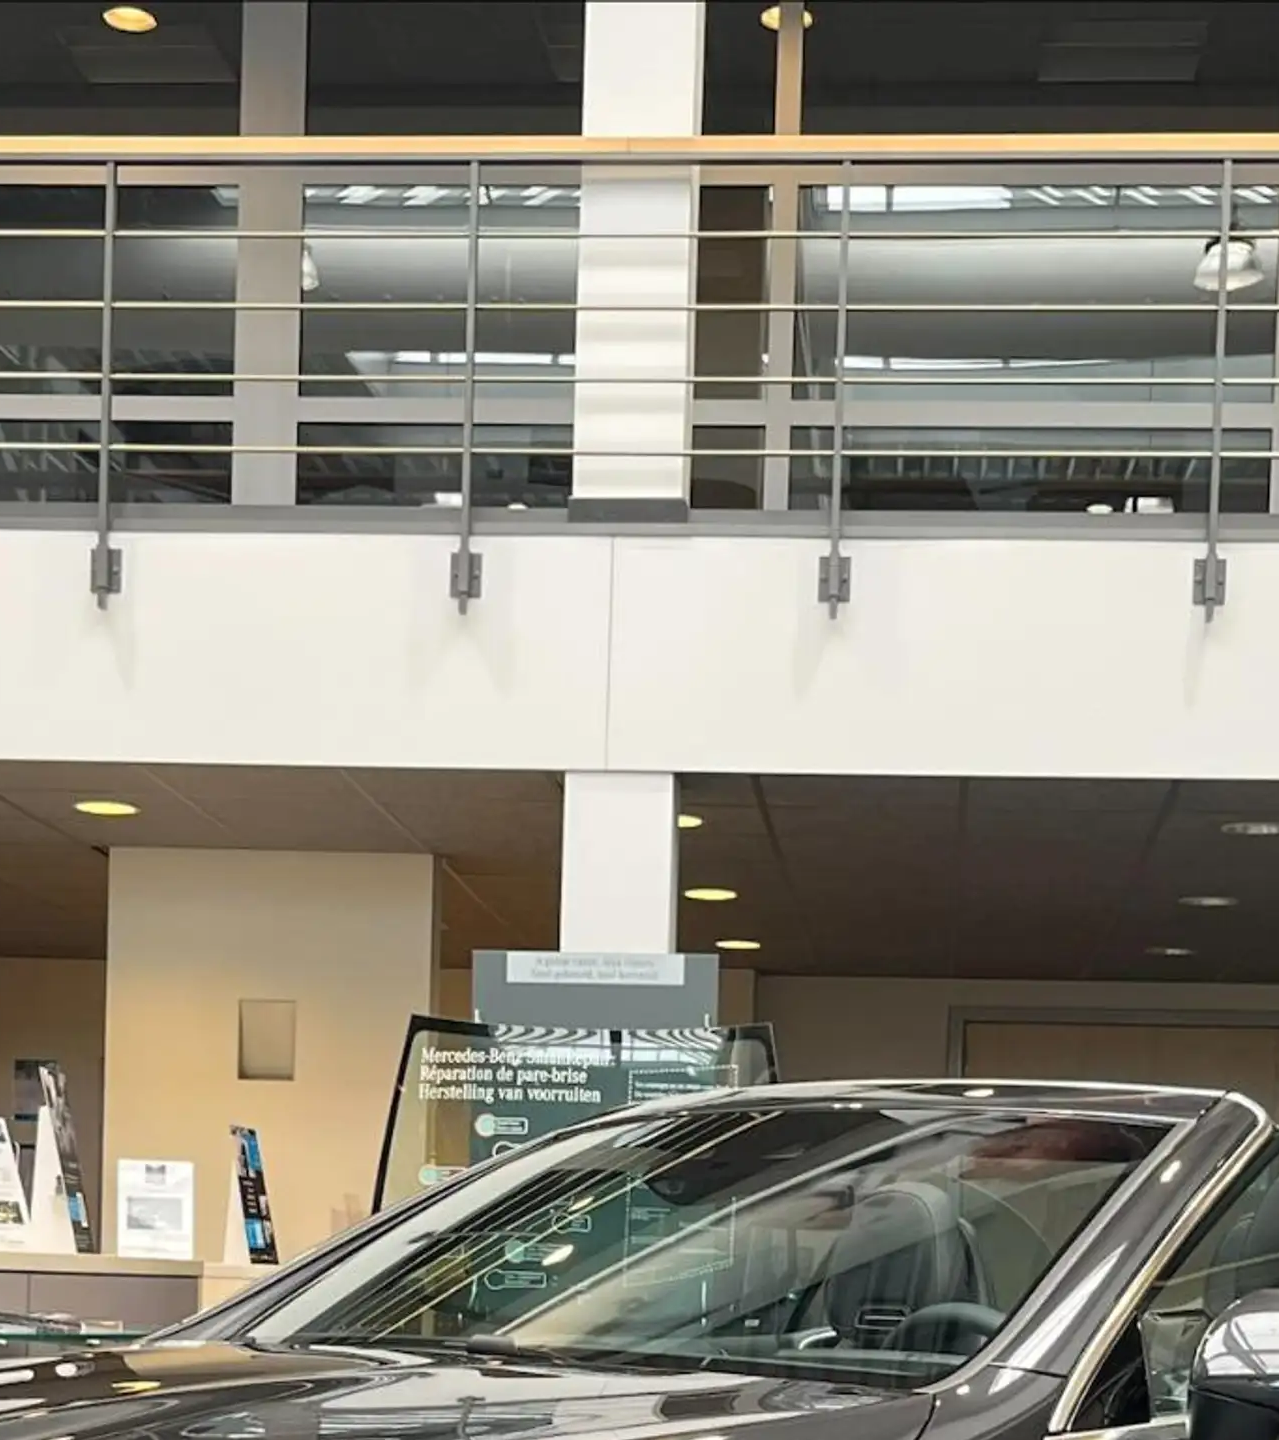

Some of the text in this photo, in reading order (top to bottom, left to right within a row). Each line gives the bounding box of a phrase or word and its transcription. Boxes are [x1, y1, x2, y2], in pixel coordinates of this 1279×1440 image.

[420, 1046, 522, 1067] Mercedes-Benz
[419, 1064, 588, 1086] Réparation de pare-brise
[418, 1083, 602, 1104] Herstelling van voorruiten
